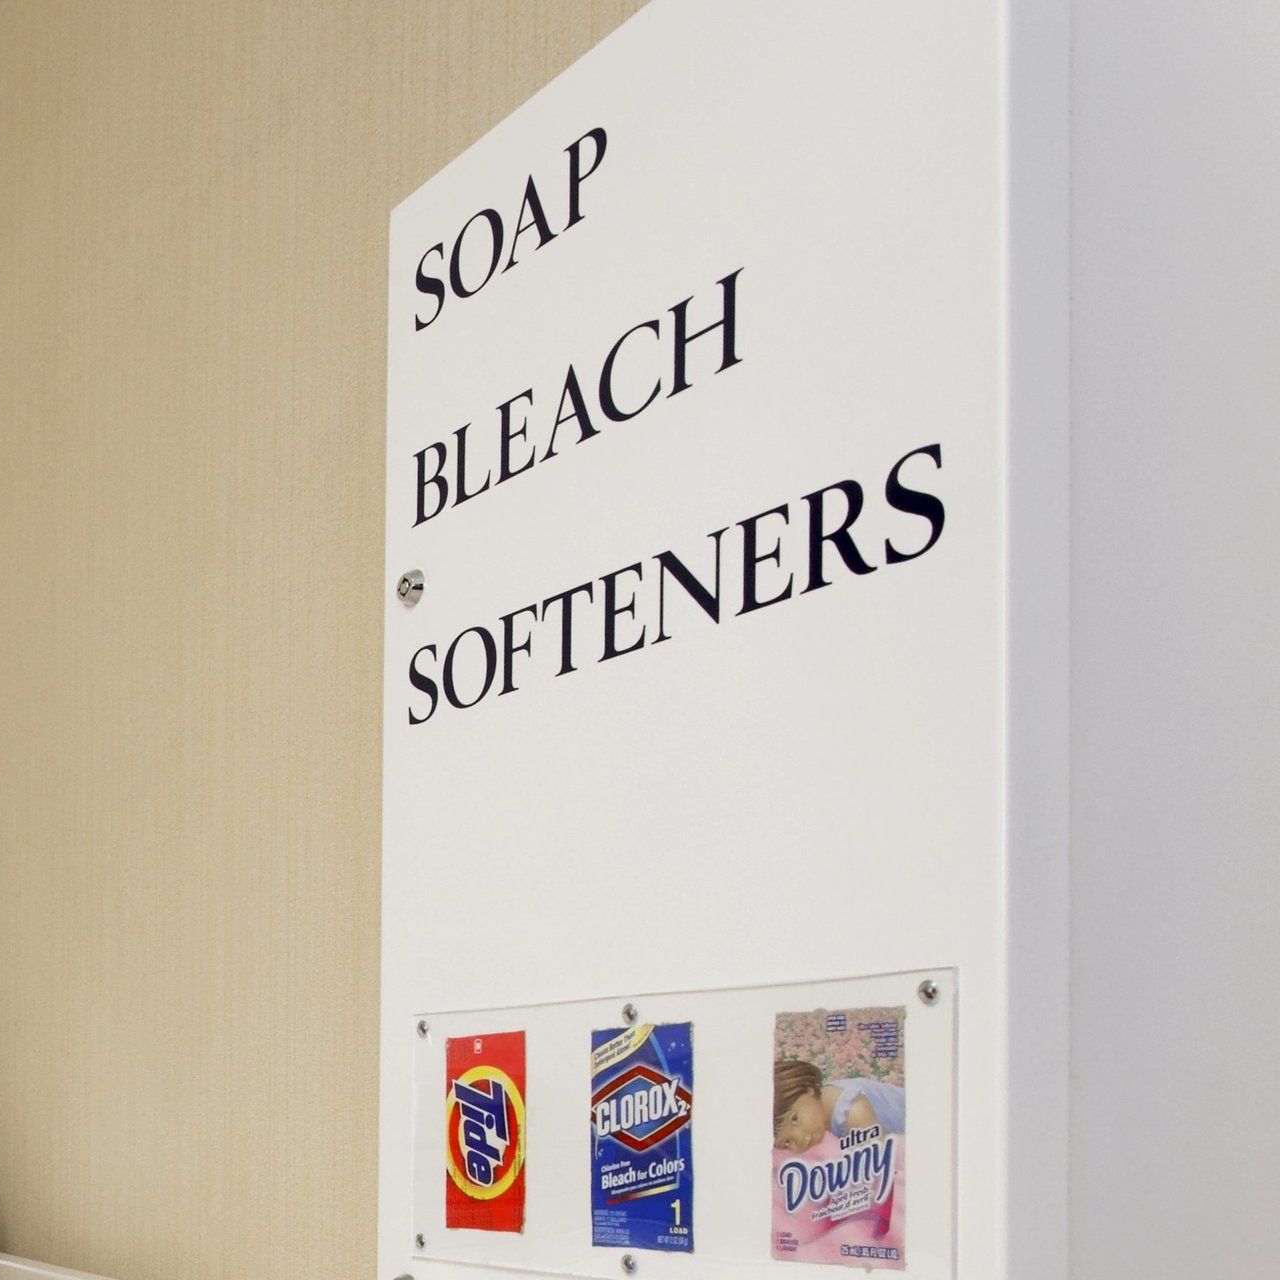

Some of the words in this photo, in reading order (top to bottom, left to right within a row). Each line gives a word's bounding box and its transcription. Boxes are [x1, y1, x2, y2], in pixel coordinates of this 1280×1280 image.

[414, 126, 608, 332] SOAP
[411, 266, 744, 528] BLEACH
[408, 443, 946, 725] SOFTENERS
[452, 1079, 510, 1187] Tide
[840, 1125, 880, 1150] ultra
[601, 1167, 636, 1190] Bleach
[637, 1170, 647, 1180] for
[648, 1158, 685, 1178] Colors
[779, 1138, 893, 1211] Downy
[669, 1227, 689, 1235] LOAD
[671, 1199, 681, 1226] 1
